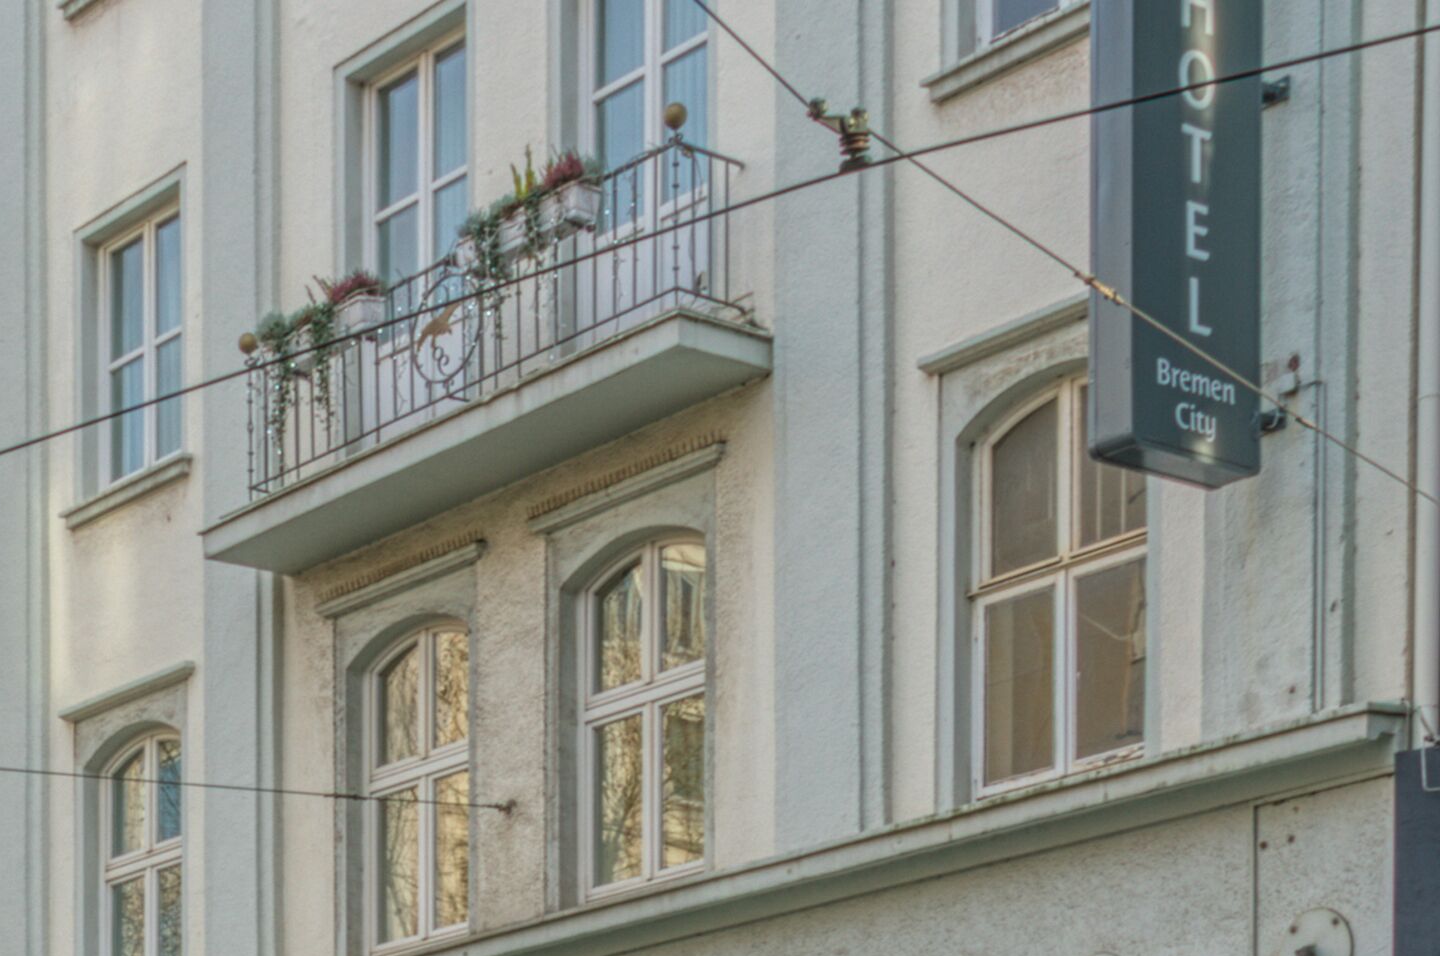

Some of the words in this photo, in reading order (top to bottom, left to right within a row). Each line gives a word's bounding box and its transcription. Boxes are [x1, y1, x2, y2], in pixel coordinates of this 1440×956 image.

[1178, 0, 1216, 337] HOTEL
[1156, 357, 1237, 405] Bremen
[1174, 402, 1218, 443] City
